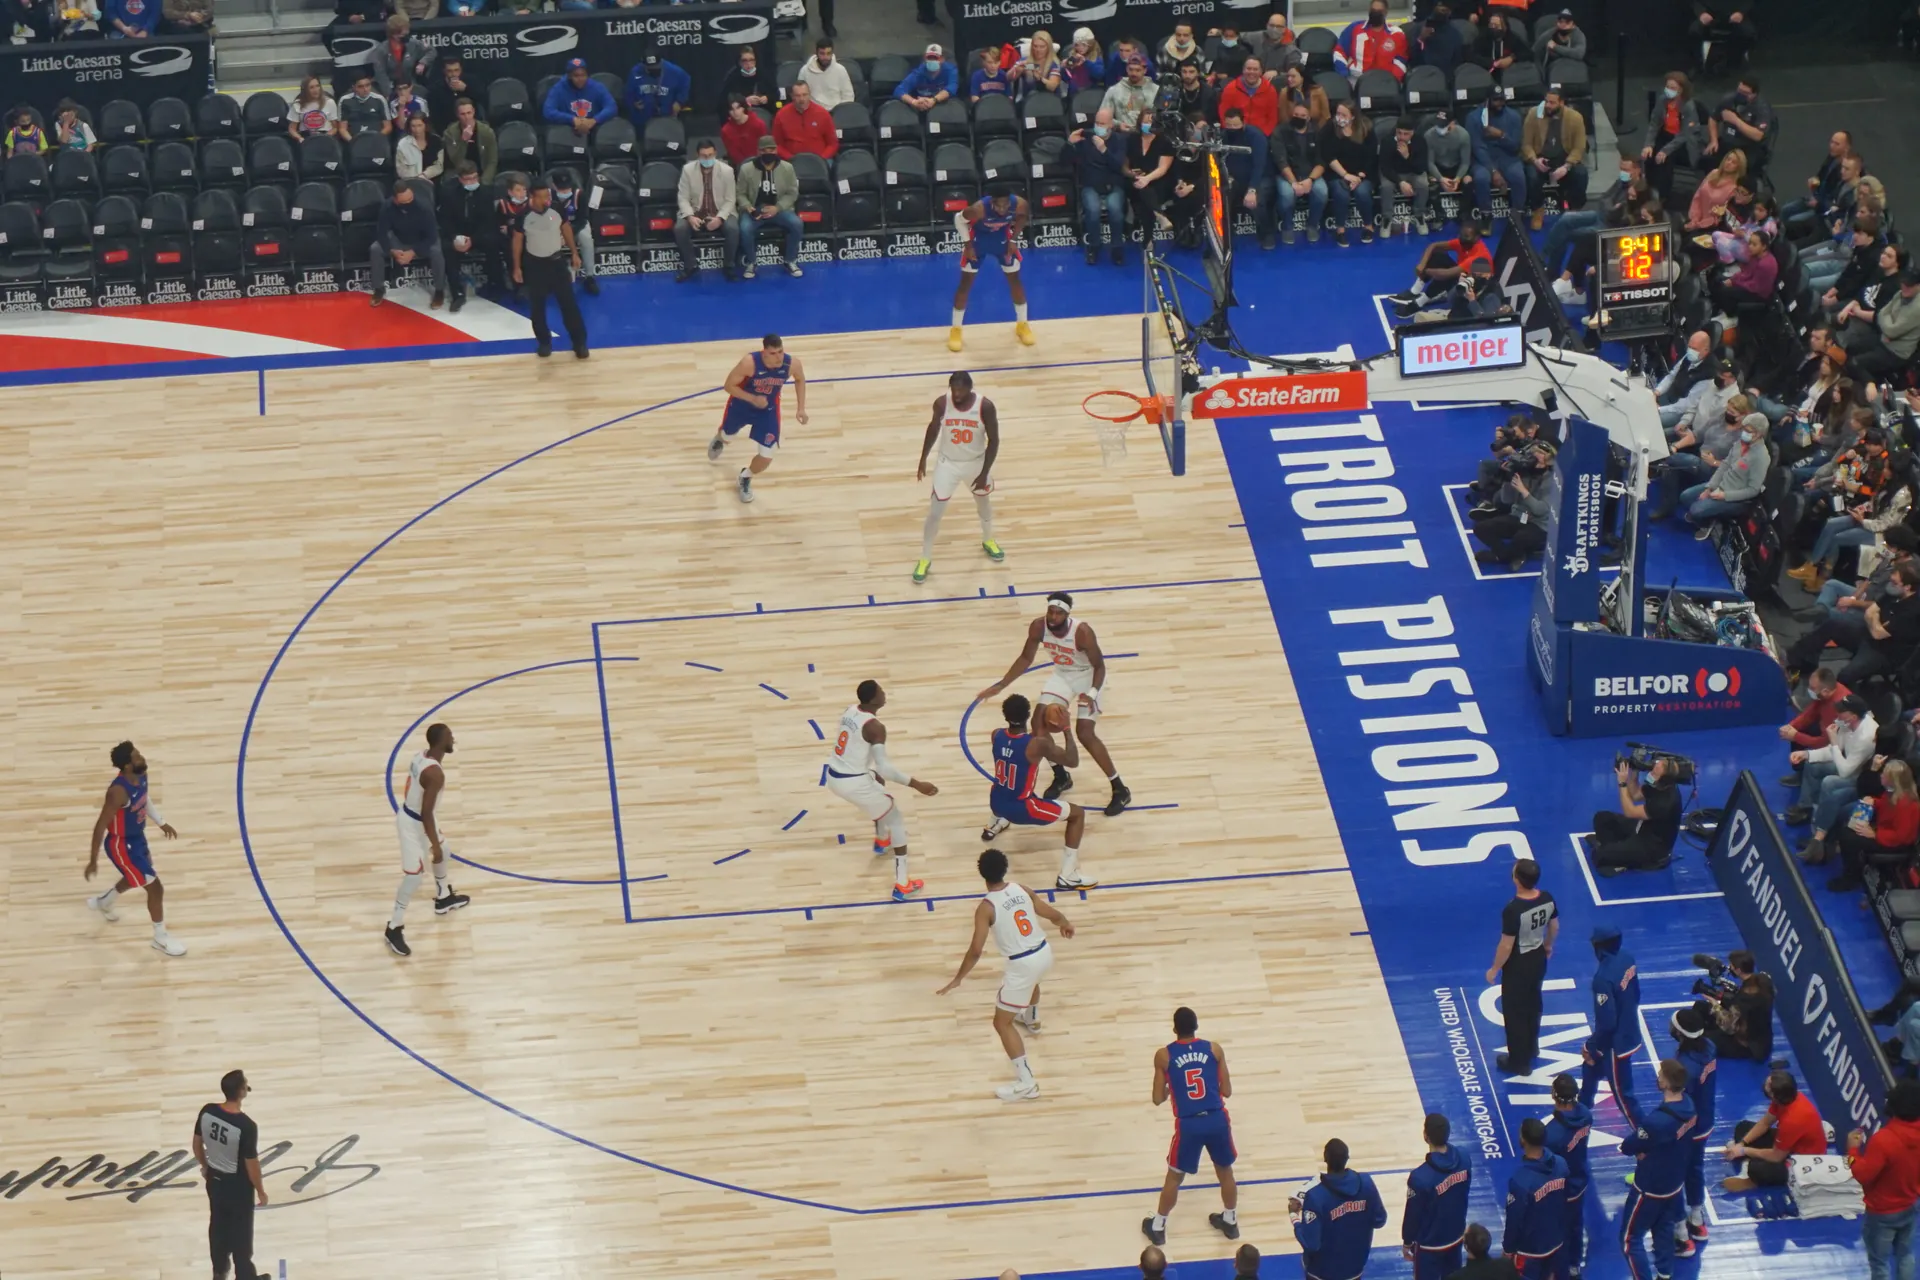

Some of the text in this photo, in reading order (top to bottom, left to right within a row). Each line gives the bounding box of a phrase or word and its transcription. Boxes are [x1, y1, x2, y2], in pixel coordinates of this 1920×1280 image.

[964, 0, 1052, 18] Little Caesars
[1172, 1, 1215, 15] arena
[606, 18, 701, 36] Little Caesars
[1011, 13, 1053, 27] arena
[451, 31, 508, 46] Caesars
[657, 32, 702, 46] arena
[463, 45, 509, 59] arena
[22, 54, 121, 72] Little Caesars
[75, 68, 123, 82] arena
[1042, 225, 1072, 237] Little
[799, 240, 828, 253] Little
[847, 237, 877, 249] Little
[896, 235, 925, 246] Little
[1034, 235, 1077, 248] Caesars
[1620, 234, 1660, 256] 9:41
[650, 250, 680, 262] Little
[757, 244, 779, 257] ittle
[797, 251, 832, 263] aesars
[839, 247, 882, 260] Caesars
[888, 244, 931, 257] Caesars
[601, 253, 631, 265] Little
[642, 260, 684, 272] Caesars
[593, 263, 636, 276] Caesars
[1628, 255, 1652, 279] 12
[206, 277, 236, 291] Little
[255, 274, 285, 287] Little
[304, 271, 334, 284] Little
[56, 286, 87, 299] Little
[105, 284, 136, 297] Little
[155, 282, 186, 294] Little
[197, 288, 241, 301] Caesars
[247, 284, 290, 297] Caesars
[295, 282, 339, 294] Caesars
[1621, 286, 1668, 300] TISSOT
[6, 290, 37, 303] Little
[48, 297, 92, 309] Caesars
[98, 295, 141, 308] Caesars
[147, 292, 191, 304] Caesars
[0, 301, 42, 313] Caesars
[1417, 333, 1509, 365] meijer
[951, 428, 973, 445] 30
[1589, 473, 1601, 547] SPORTSBOOK
[1575, 473, 1589, 573] DRAFTKINGS
[1595, 674, 1689, 696] BELFOR
[1594, 700, 1741, 714] PROPERTY RESTORATION
[1328, 595, 1535, 866] PISTONS
[835, 730, 849, 756] 9
[996, 759, 1017, 791] 41
[1740, 845, 1803, 983] FANDUEL
[1013, 909, 1033, 937] 6
[1175, 1051, 1209, 1069] JACKSON
[1433, 986, 1503, 1160] UNITED WHOLESALE MORTGAGE
[1184, 1067, 1207, 1100] 5
[208, 1120, 230, 1146] 35
[1435, 1169, 1468, 1195] DETROIT
[1330, 1199, 1367, 1221] DETROIT
